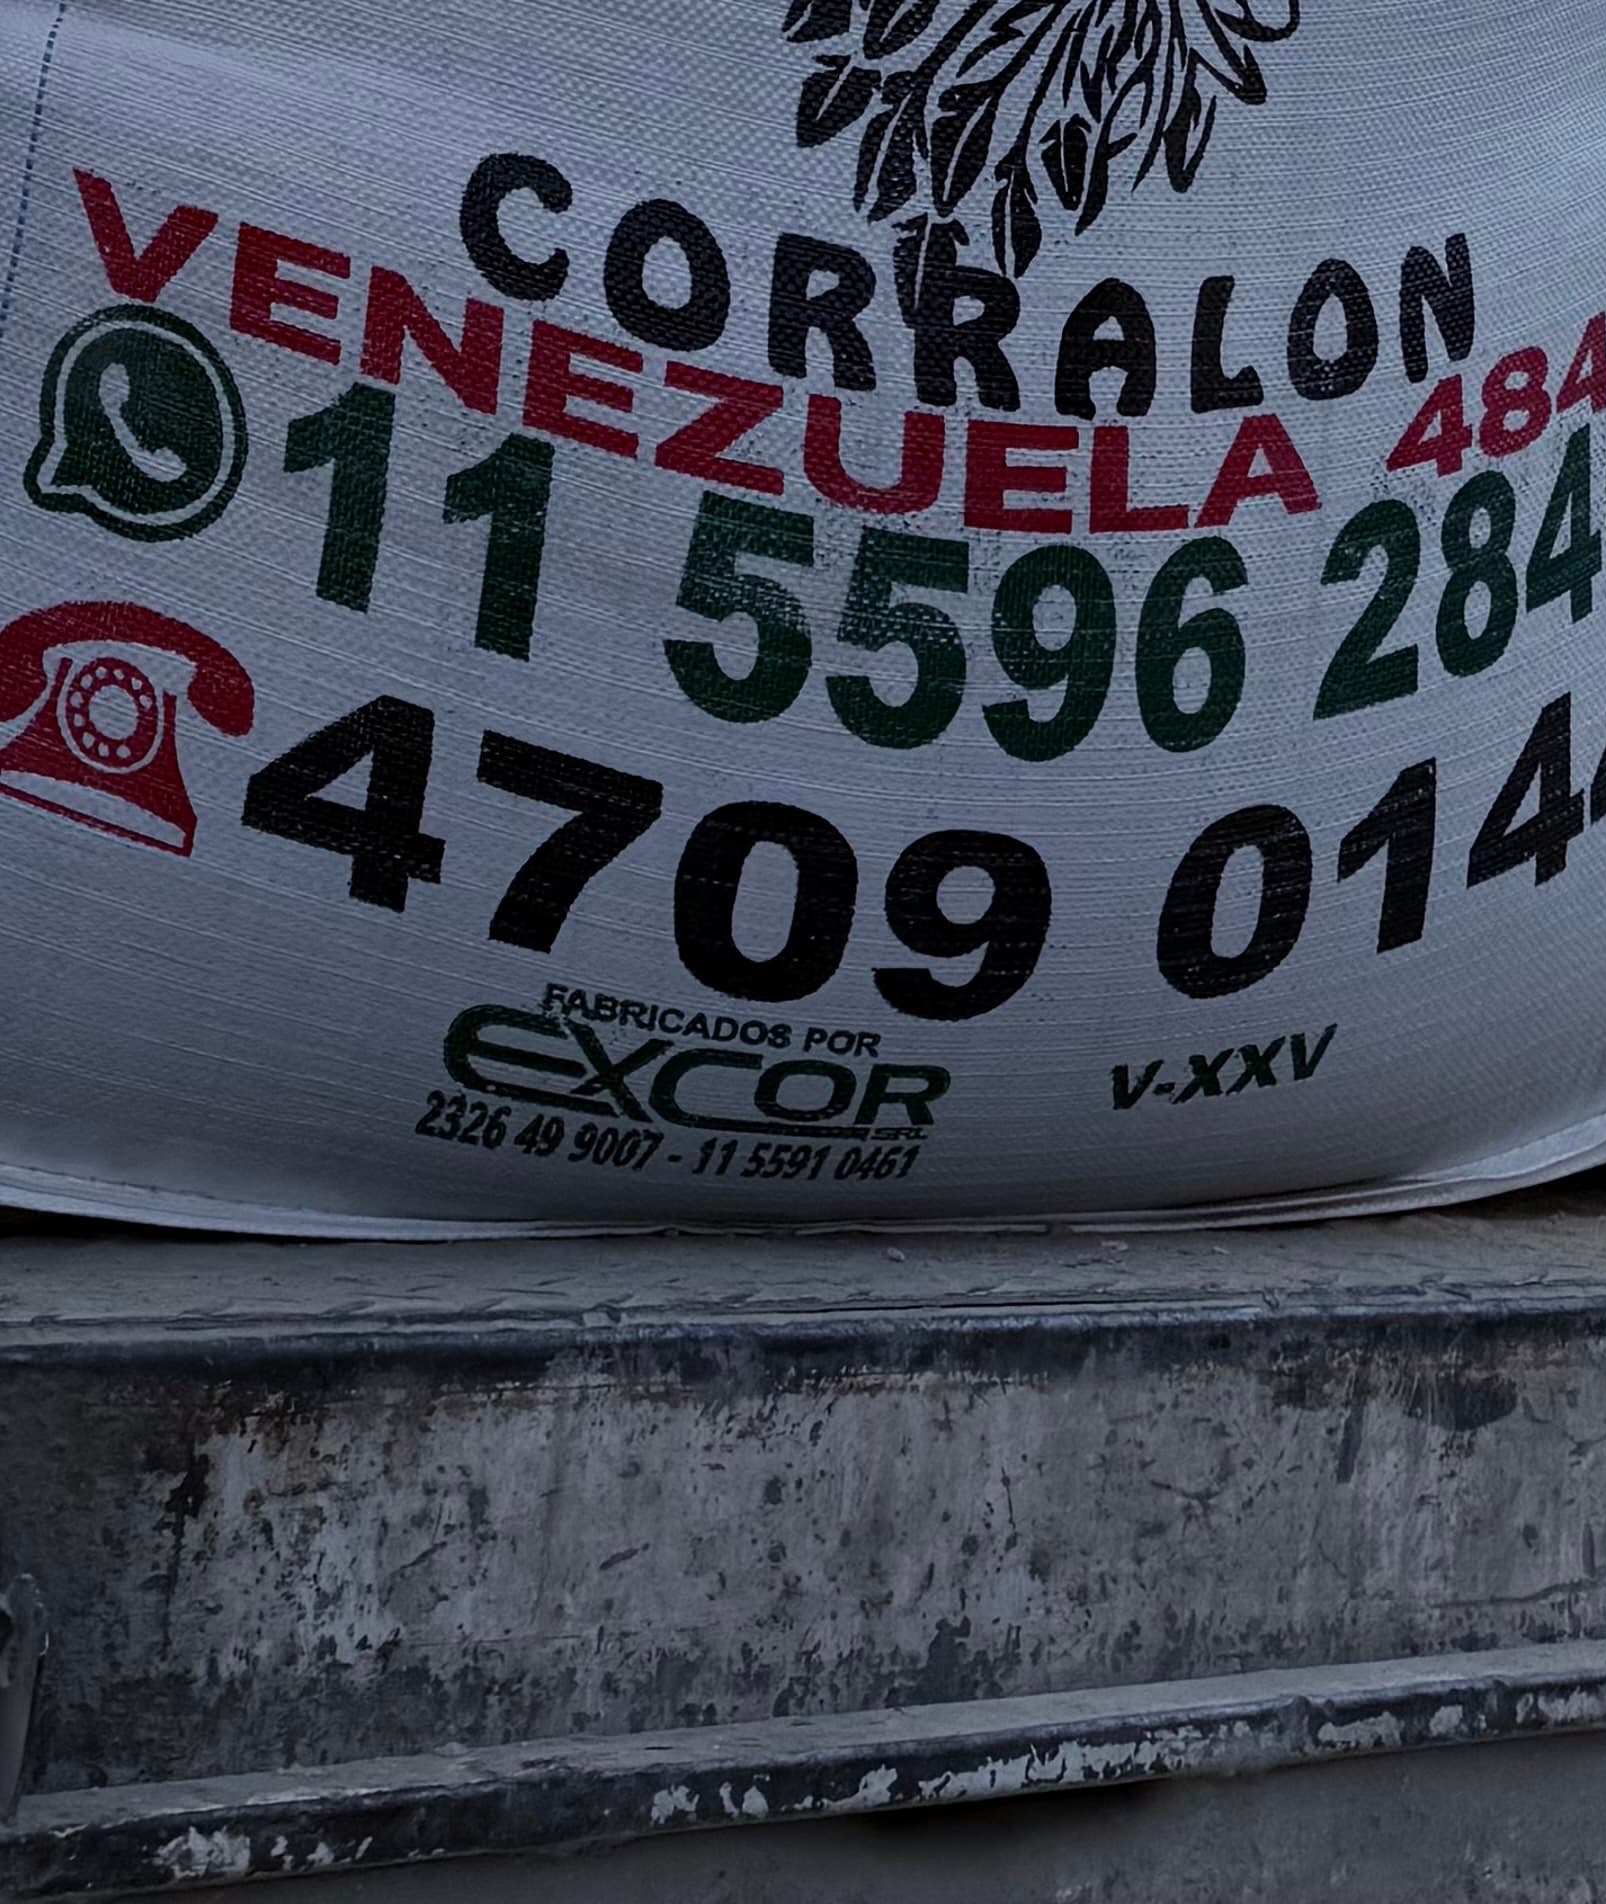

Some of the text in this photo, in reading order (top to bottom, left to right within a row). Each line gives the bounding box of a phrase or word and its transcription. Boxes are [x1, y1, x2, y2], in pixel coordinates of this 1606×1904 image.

[73, 169, 1318, 534] VENEZUELA
[460, 152, 1474, 418] CORRALON
[283, 389, 554, 662] 11
[662, 491, 1246, 761] 5596
[242, 695, 1052, 1022] 4709
[443, 1004, 951, 1141] EXCOR
[542, 983, 881, 1056] FABRICADOS POR
[1108, 1026, 1336, 1114] V-XXV
[415, 1090, 509, 1149] 2326
[515, 1113, 564, 1157] 49
[568, 1124, 664, 1171] 9007
[693, 1137, 733, 1175] 11
[741, 1141, 831, 1180] 5591
[835, 1145, 919, 1180] 0461
